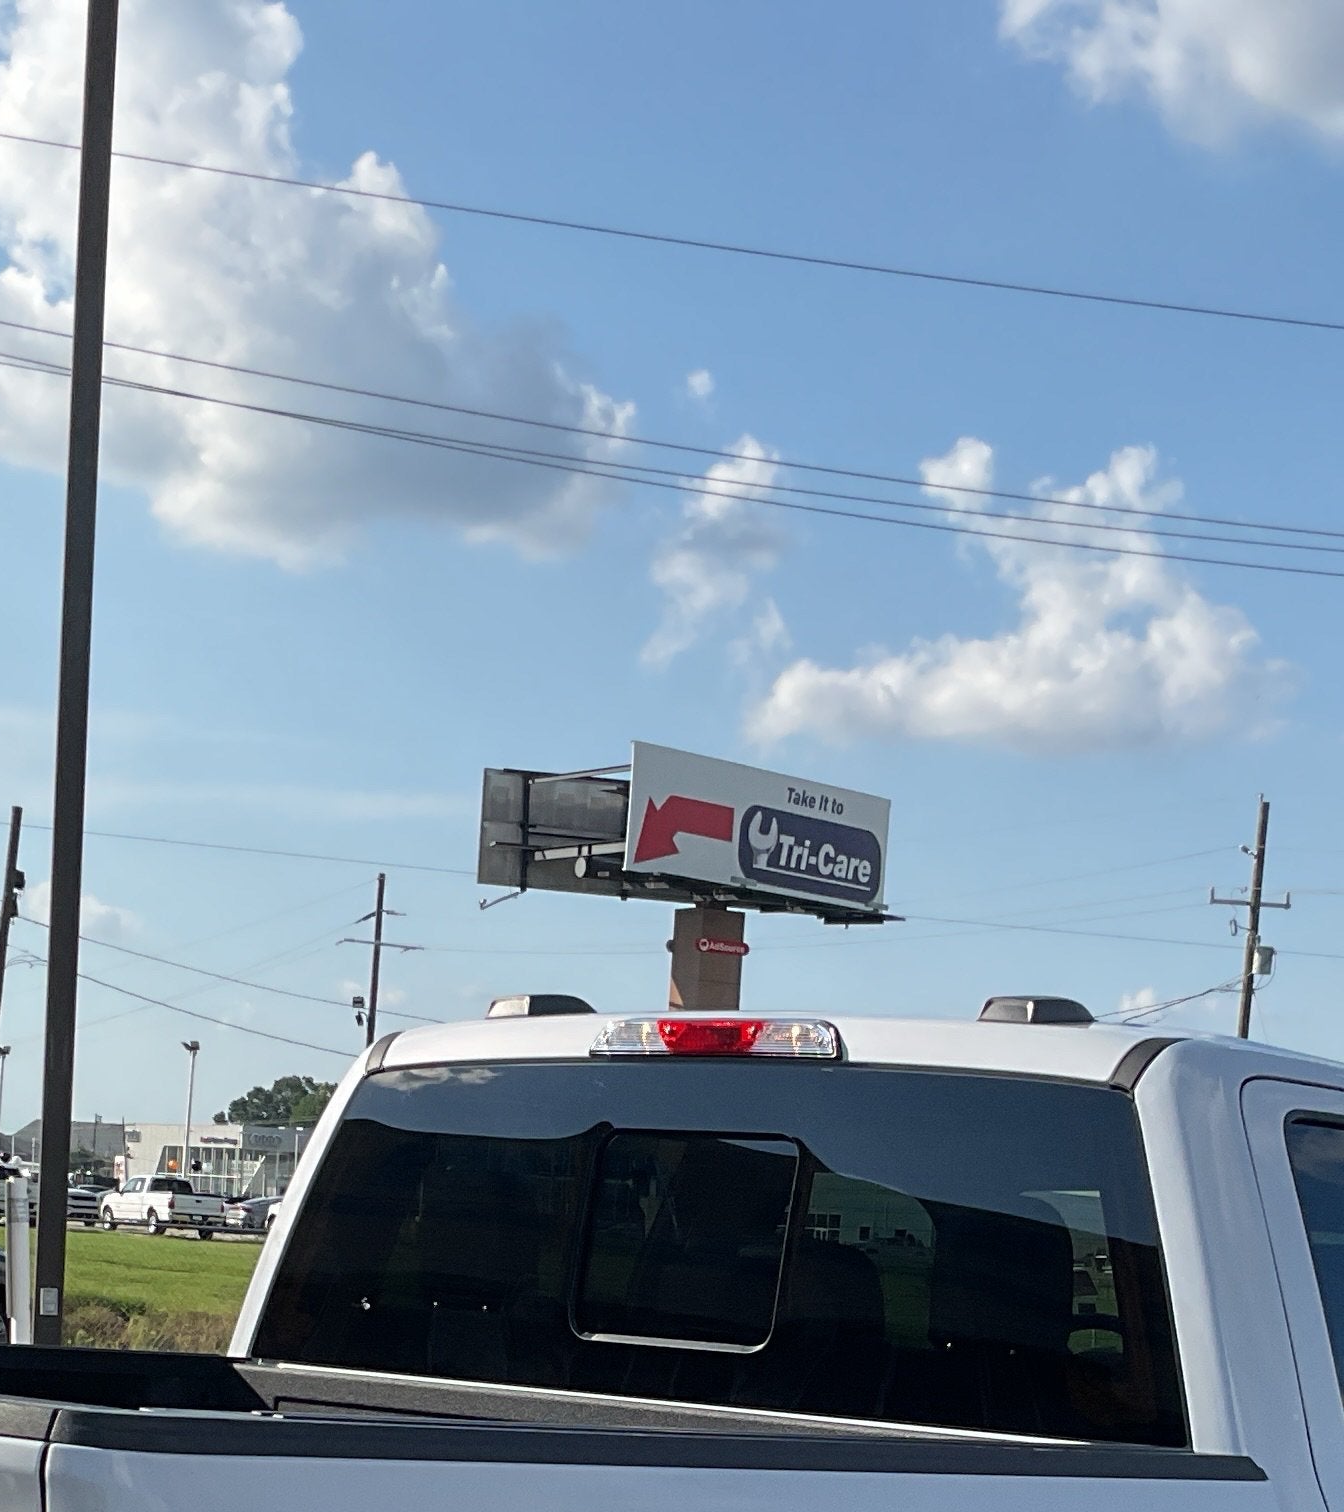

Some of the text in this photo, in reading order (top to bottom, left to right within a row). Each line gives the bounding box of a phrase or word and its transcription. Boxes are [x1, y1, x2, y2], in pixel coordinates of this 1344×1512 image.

[787, 787, 816, 809] Take
[831, 798, 844, 815] to
[779, 834, 871, 883] Tri-Care
